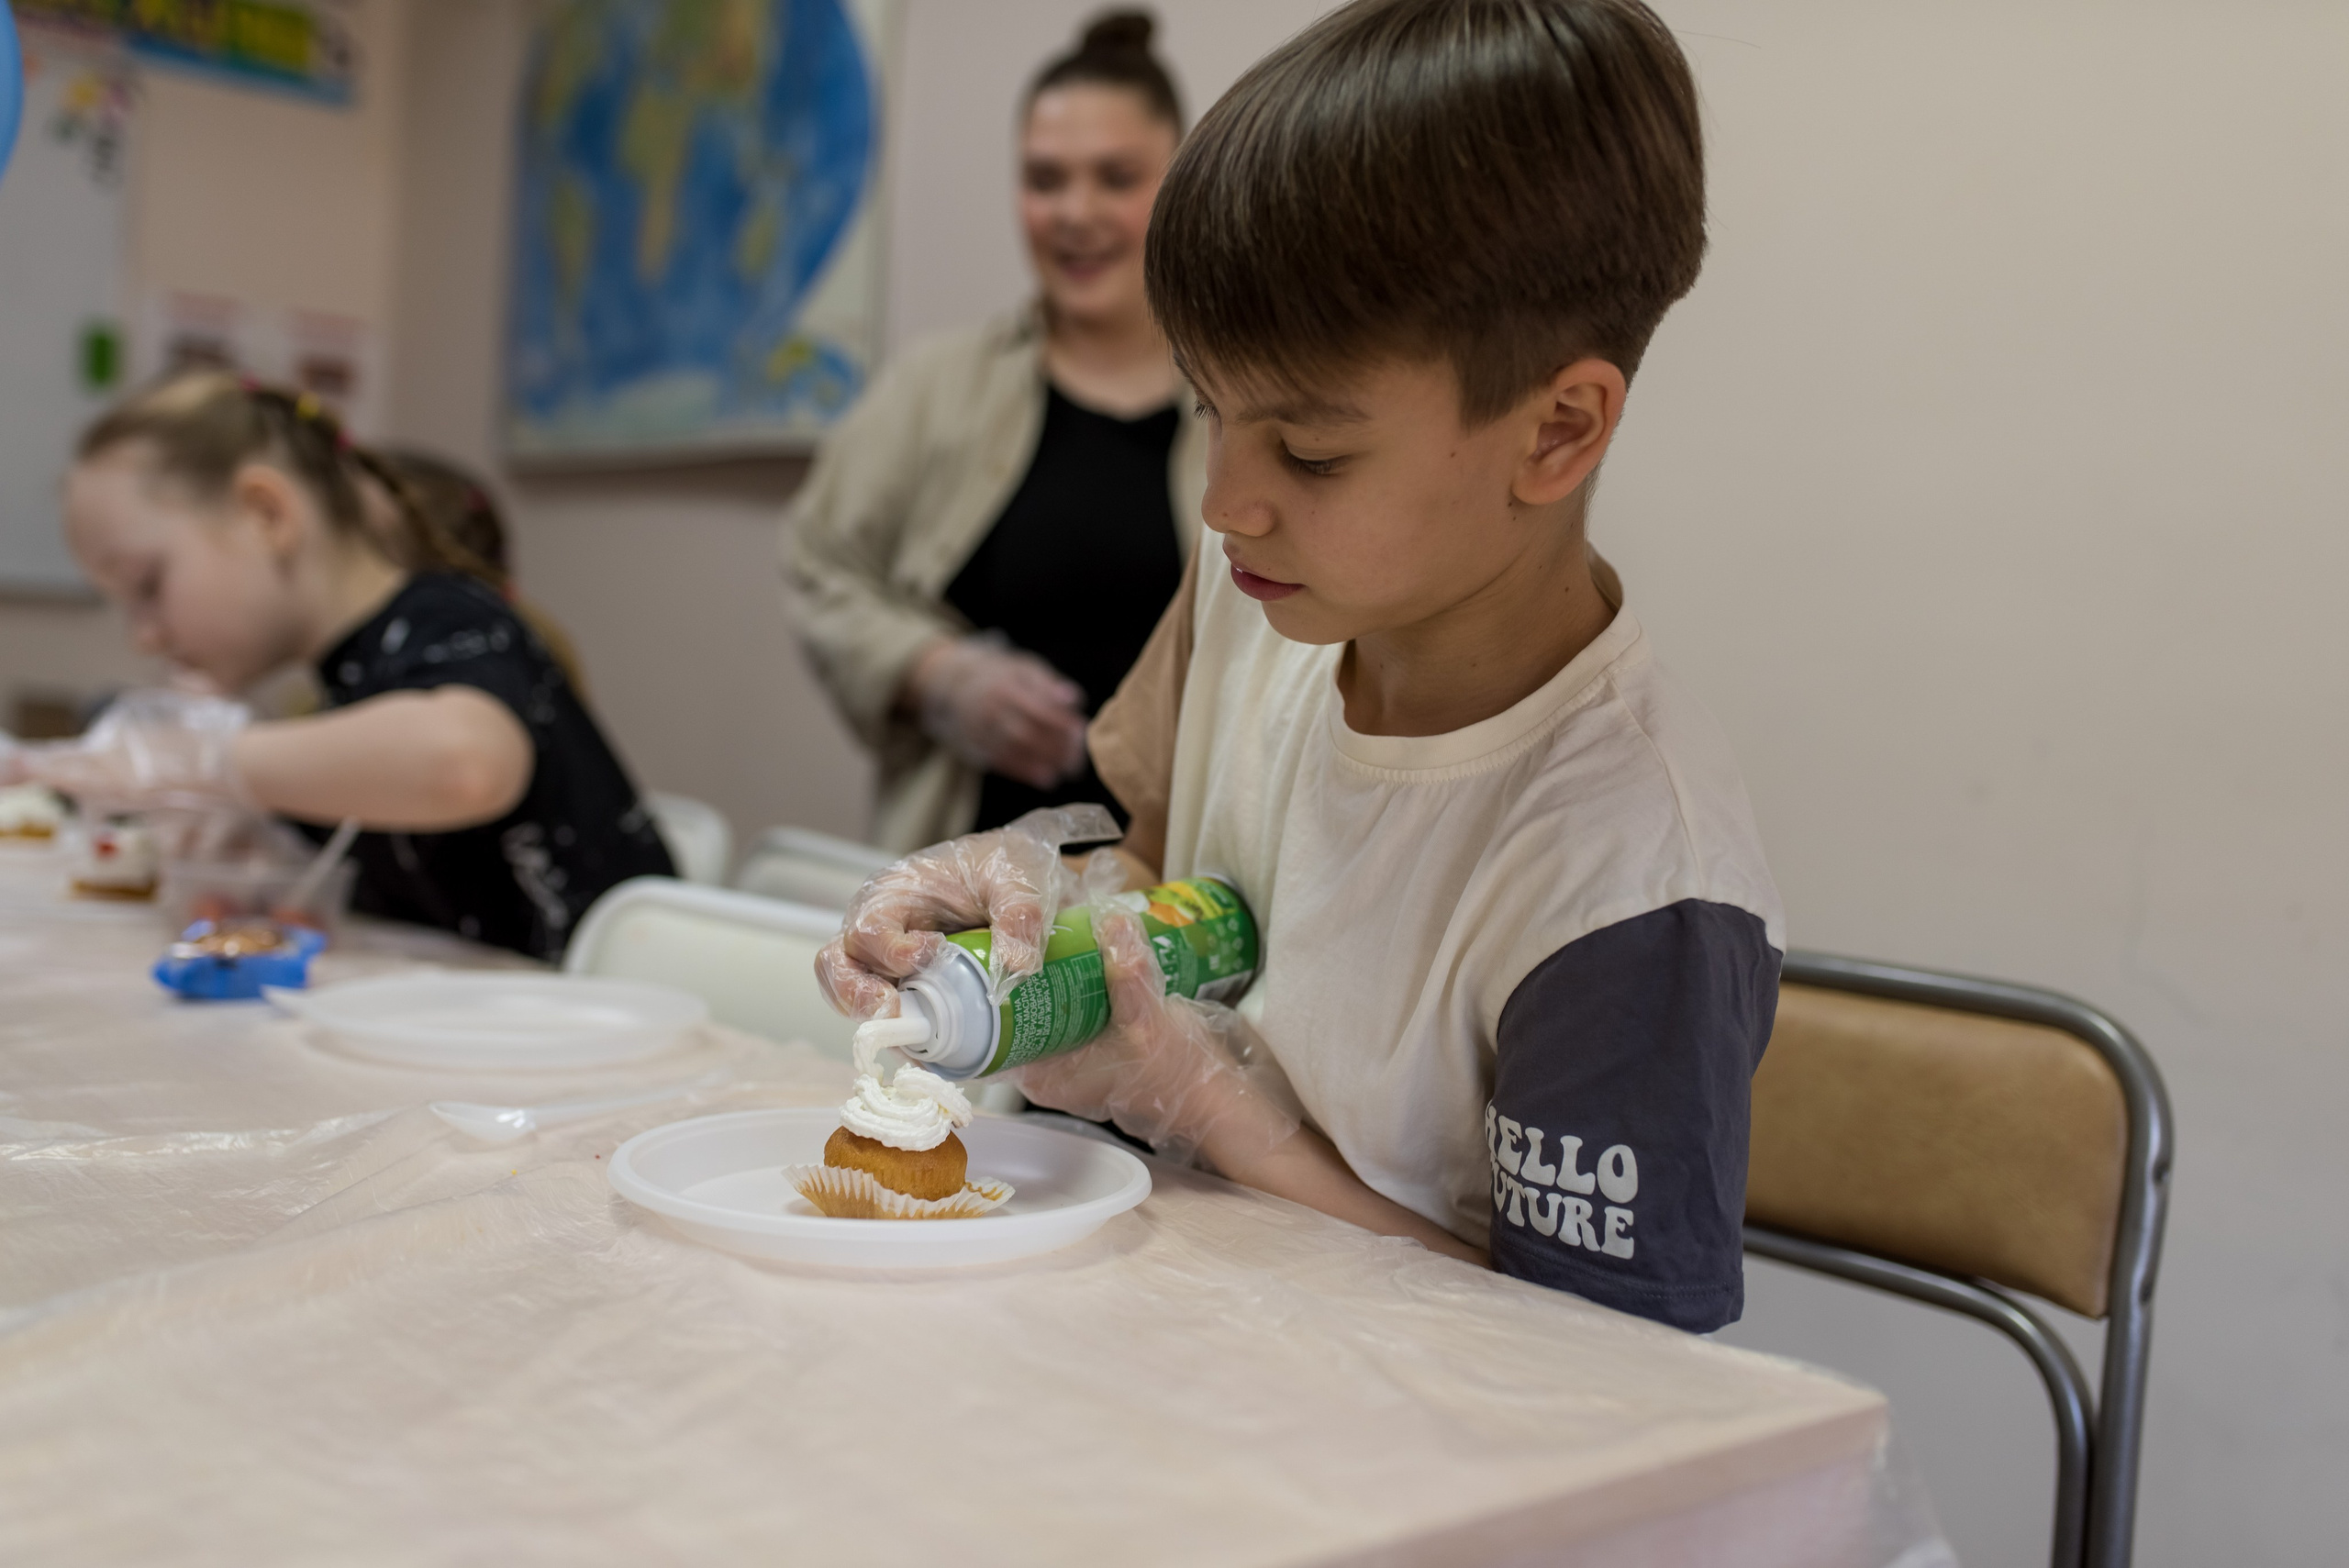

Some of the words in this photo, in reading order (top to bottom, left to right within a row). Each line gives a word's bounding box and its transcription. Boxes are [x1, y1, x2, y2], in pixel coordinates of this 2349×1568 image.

[1040, 979, 1050, 988] 24
[1014, 997, 1023, 1012] НА
[1019, 984, 1030, 1022] МАСЛАХ
[1031, 975, 1045, 1025] АЛЬПЕНГУР
[1043, 988, 1052, 1014] ЖИРА
[1042, 1014, 1052, 1036] ДОЛЯ
[1486, 1100, 1639, 1204] HELLO
[1489, 1155, 1634, 1260] UTURE
